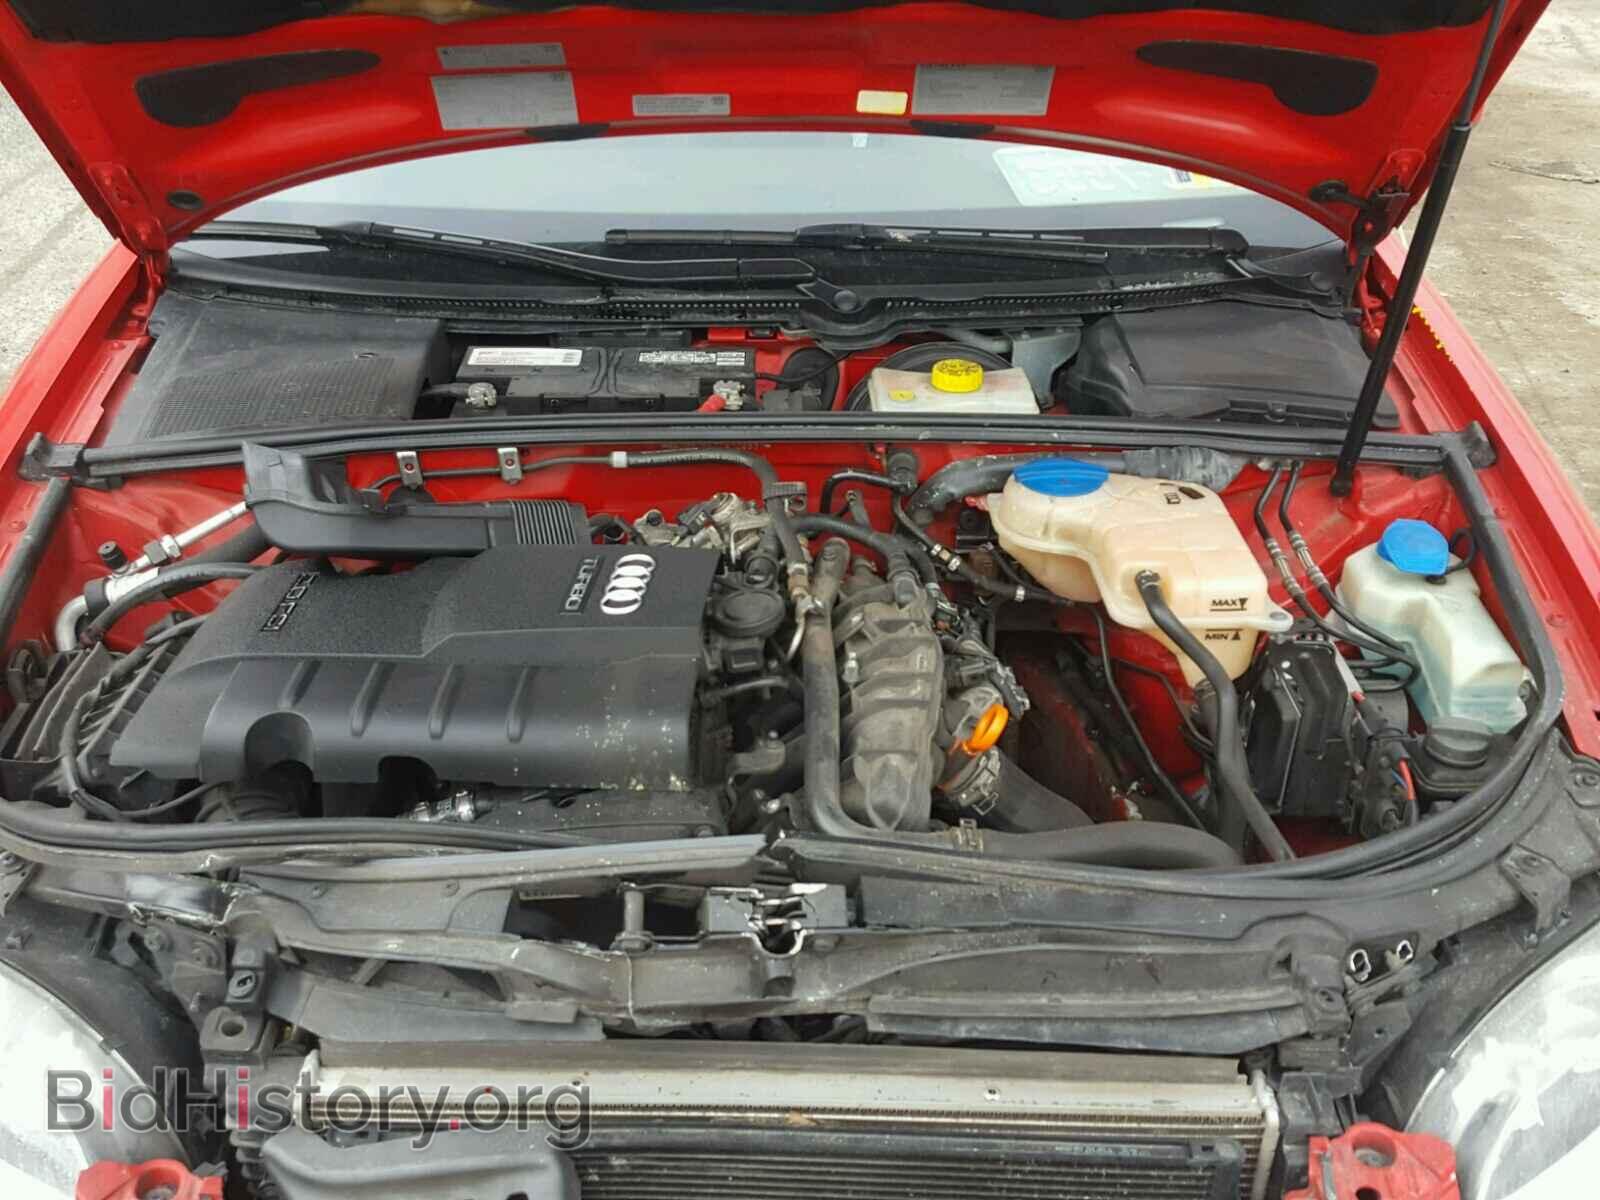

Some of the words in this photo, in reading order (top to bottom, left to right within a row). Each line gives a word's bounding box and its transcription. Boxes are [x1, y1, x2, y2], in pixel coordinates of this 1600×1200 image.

[564, 555, 600, 611] TURBO
[1211, 599, 1238, 607] MAX
[1205, 633, 1230, 641] MIN
